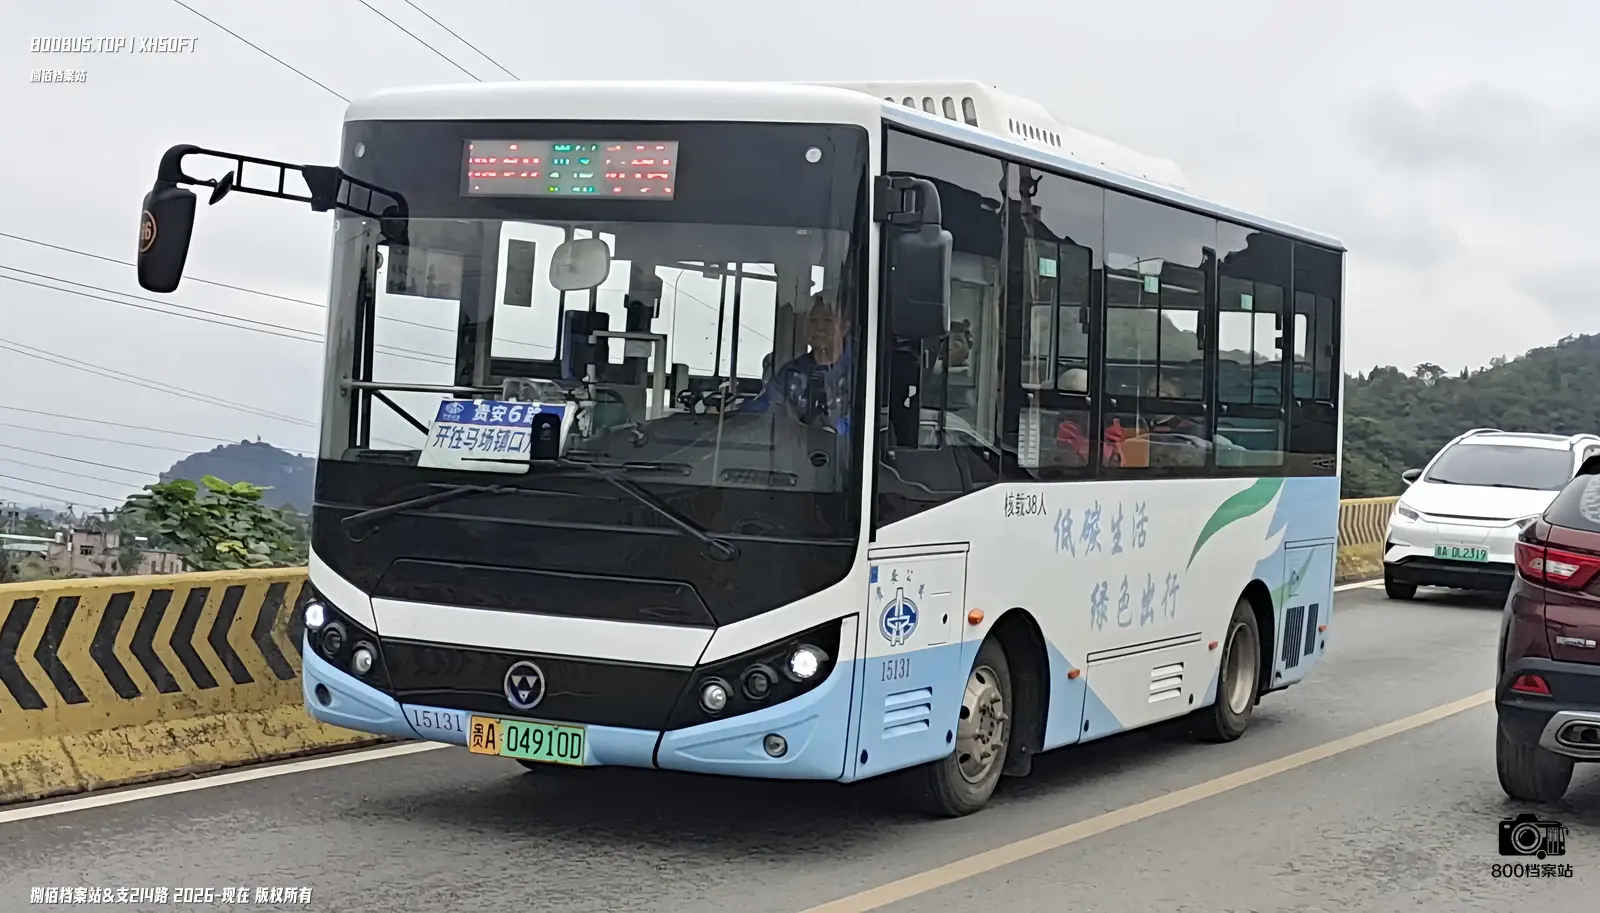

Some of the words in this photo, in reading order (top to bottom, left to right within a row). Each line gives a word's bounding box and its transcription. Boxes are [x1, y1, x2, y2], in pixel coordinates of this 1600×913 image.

[1004, 492, 1047, 517] 核载38人
[1053, 500, 1149, 558] 低碳生活
[1090, 571, 1180, 630] 绿色出行
[881, 658, 911, 681] 15131
[413, 709, 464, 732] 15131
